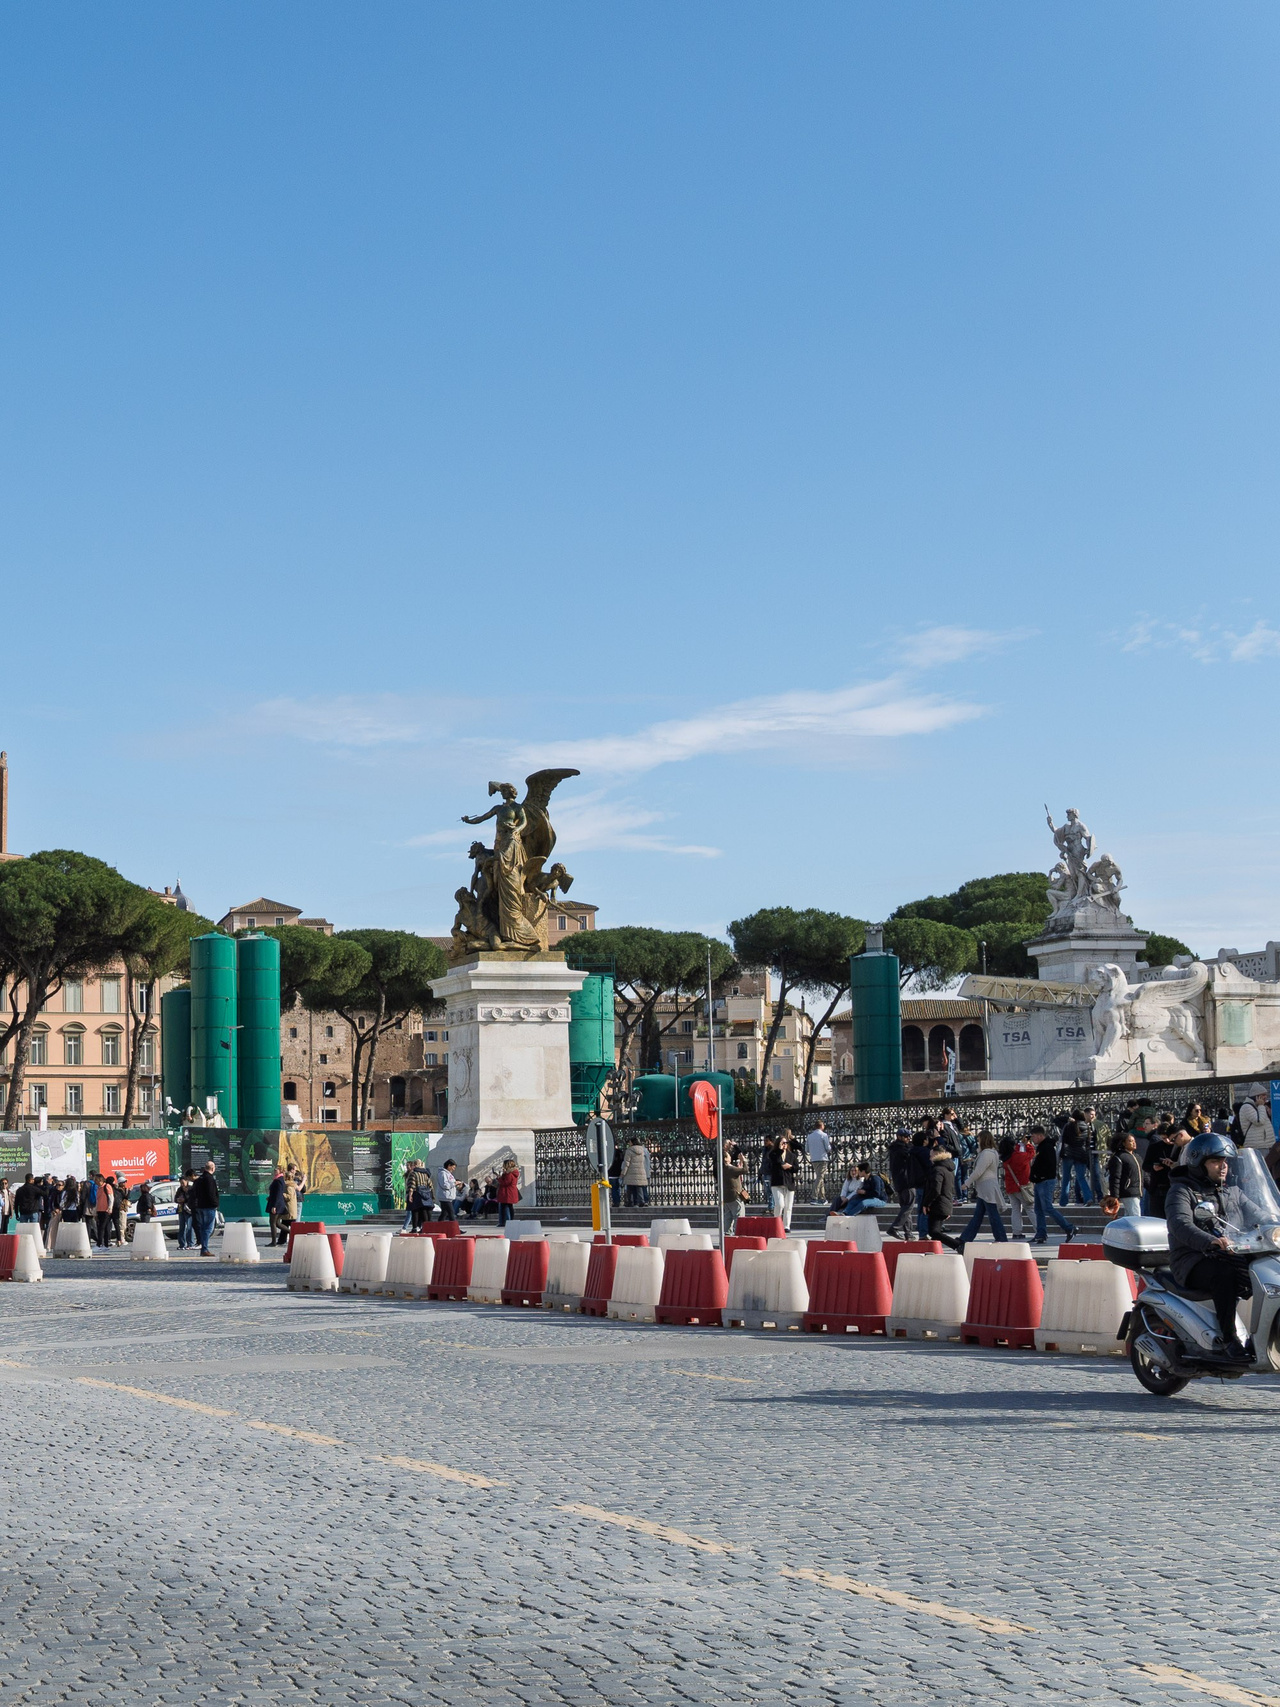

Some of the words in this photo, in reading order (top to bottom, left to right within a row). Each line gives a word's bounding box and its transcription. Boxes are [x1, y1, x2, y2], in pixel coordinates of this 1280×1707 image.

[1003, 1031, 1031, 1043] TSA
[1056, 1027, 1086, 1037] TSA
[249, 1144, 255, 1158] 4
[111, 1157, 145, 1167] webuild
[384, 1160, 393, 1191] ROMA
